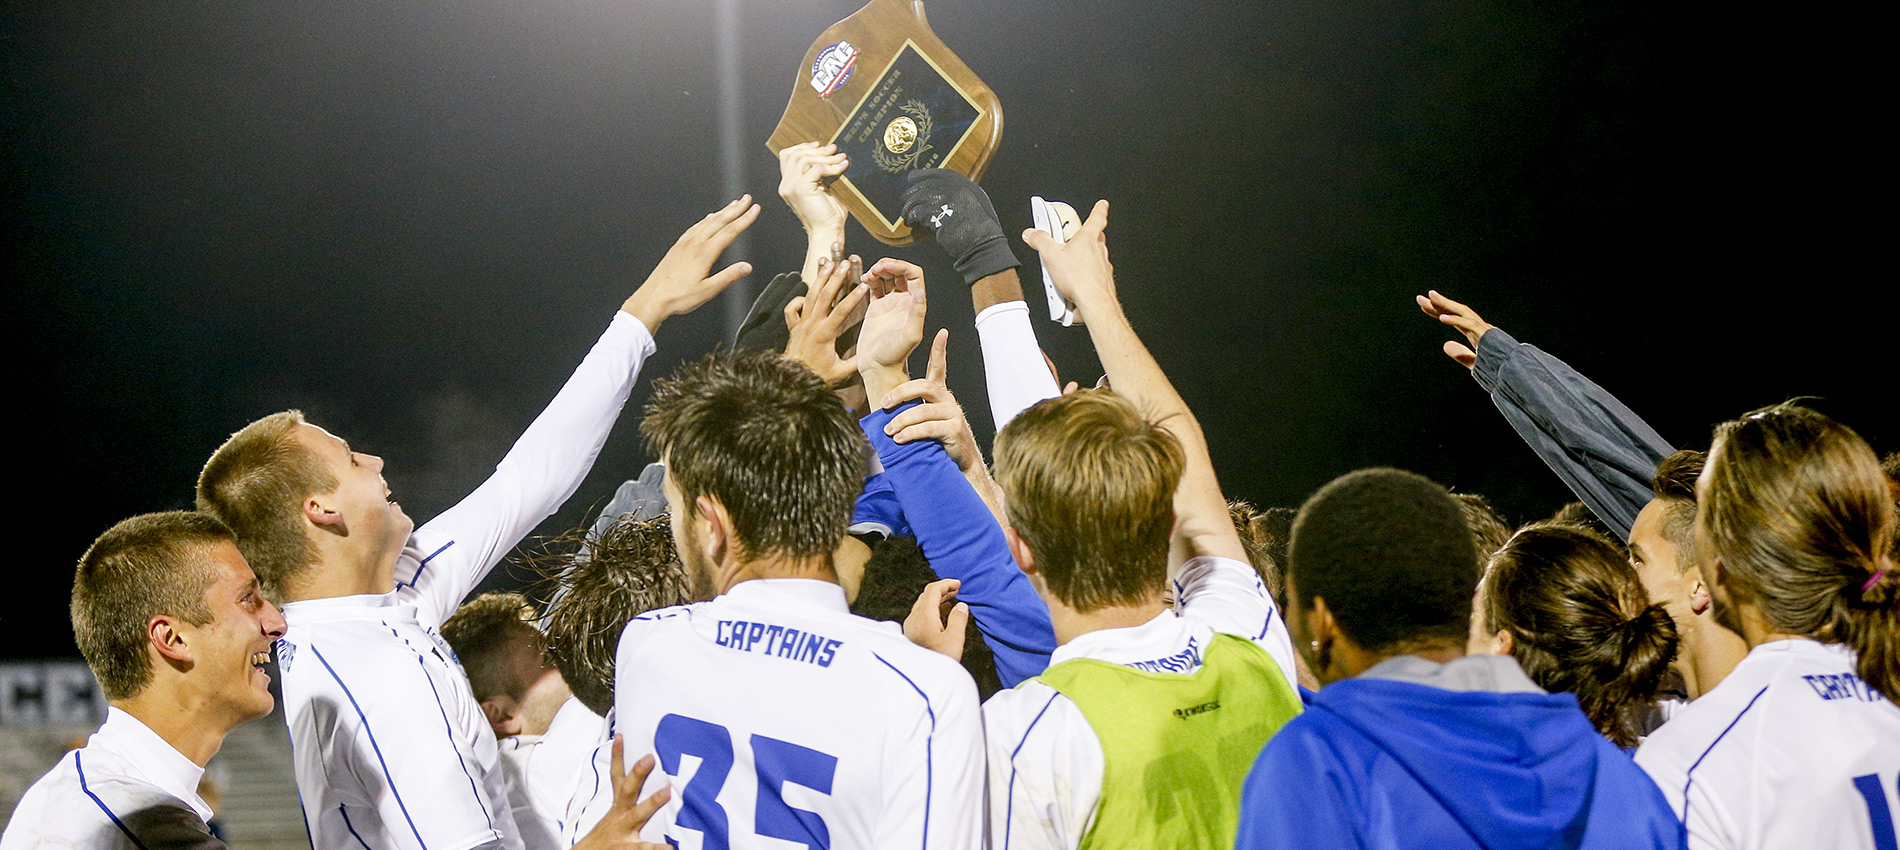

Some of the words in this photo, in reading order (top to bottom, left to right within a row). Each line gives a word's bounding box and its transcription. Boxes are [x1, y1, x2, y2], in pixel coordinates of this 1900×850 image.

[810, 40, 856, 94] CAC
[868, 69, 901, 110] SOCCER
[859, 86, 904, 143] CHAMPION
[922, 153, 939, 171] 016
[715, 619, 844, 668] CAPTAINS
[654, 712, 839, 850] 35
[1852, 770, 1900, 850] 1
